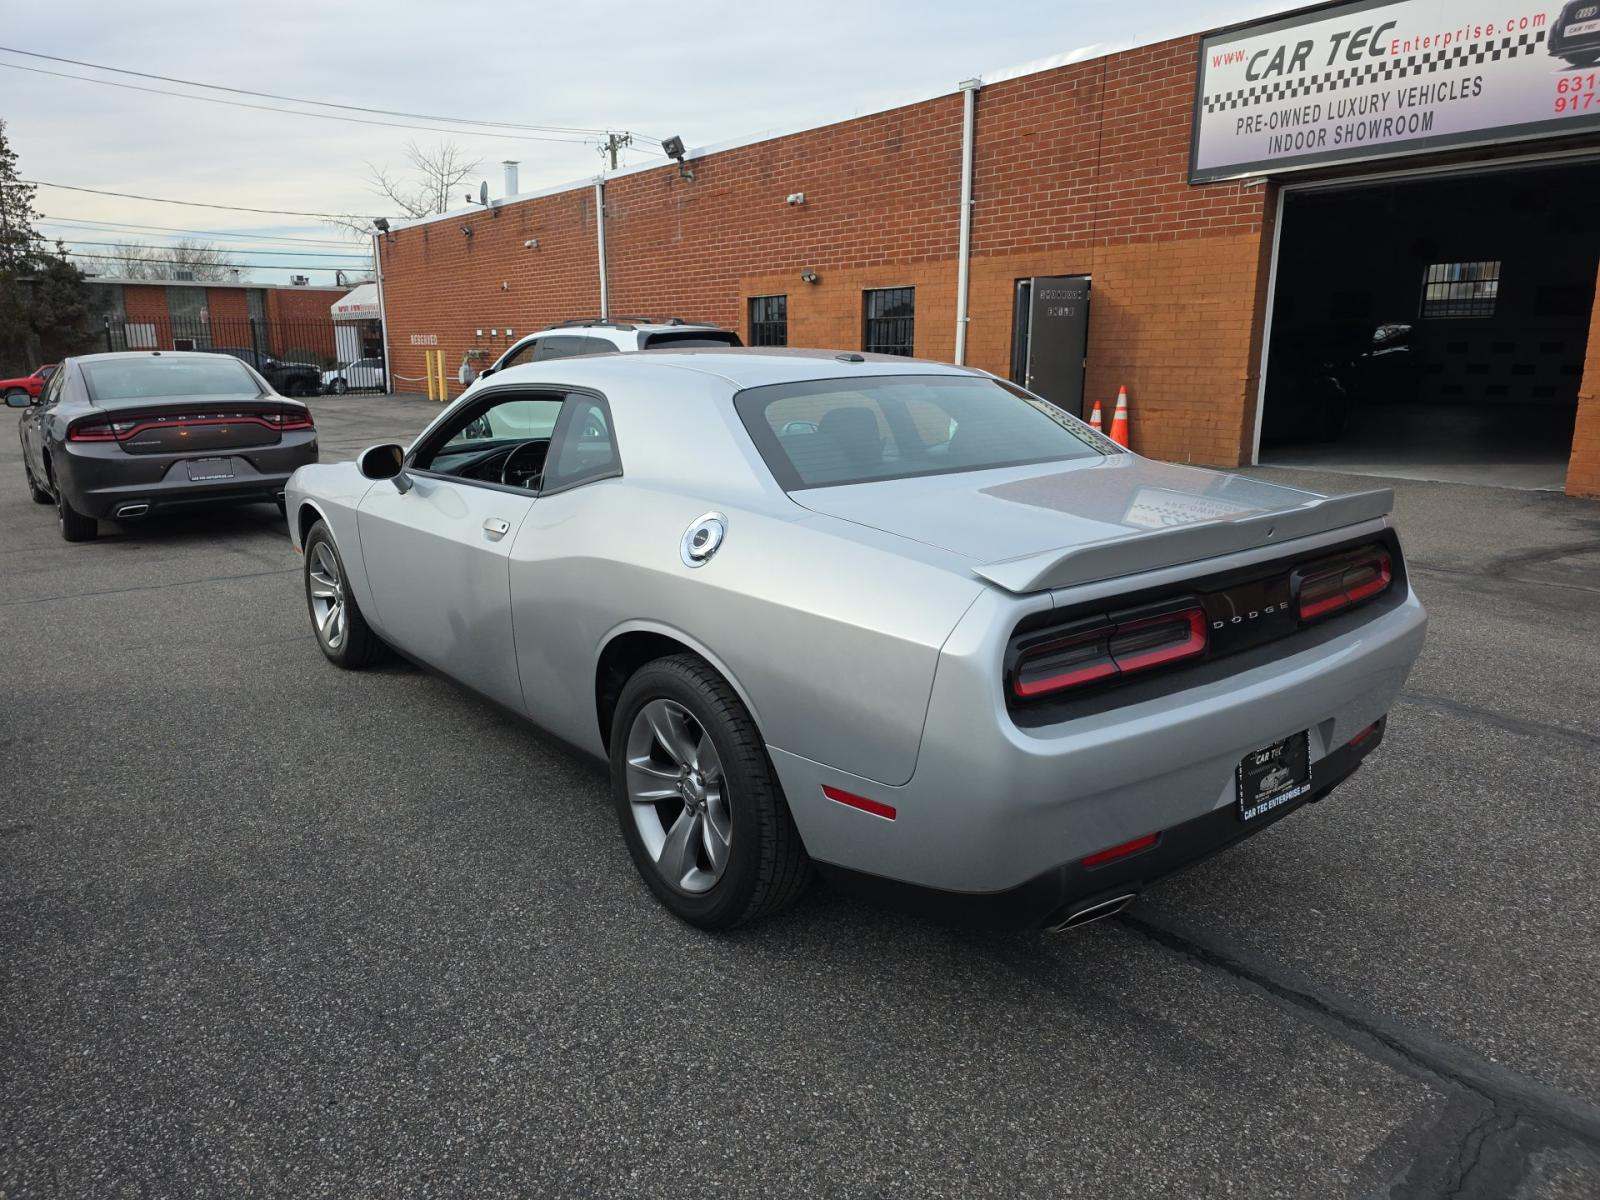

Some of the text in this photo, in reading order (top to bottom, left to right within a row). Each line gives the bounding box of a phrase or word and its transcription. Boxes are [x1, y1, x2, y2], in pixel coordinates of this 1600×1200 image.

[1569, 25, 1583, 33] CAR
[1246, 39, 1314, 82] CAR
[1326, 20, 1398, 67] TEC
[1390, 13, 1546, 55] Enterprise.com
[1236, 75, 1483, 136] PRE-OWNED LUXURY VEHICLES
[1268, 110, 1434, 154] INDOOR SHOWROOM
[410, 334, 438, 346] RESERVED
[1213, 602, 1289, 629] DODGE
[1255, 752, 1270, 765] CAR
[1244, 808, 1257, 821] CAR
[1257, 802, 1268, 815] TEC
